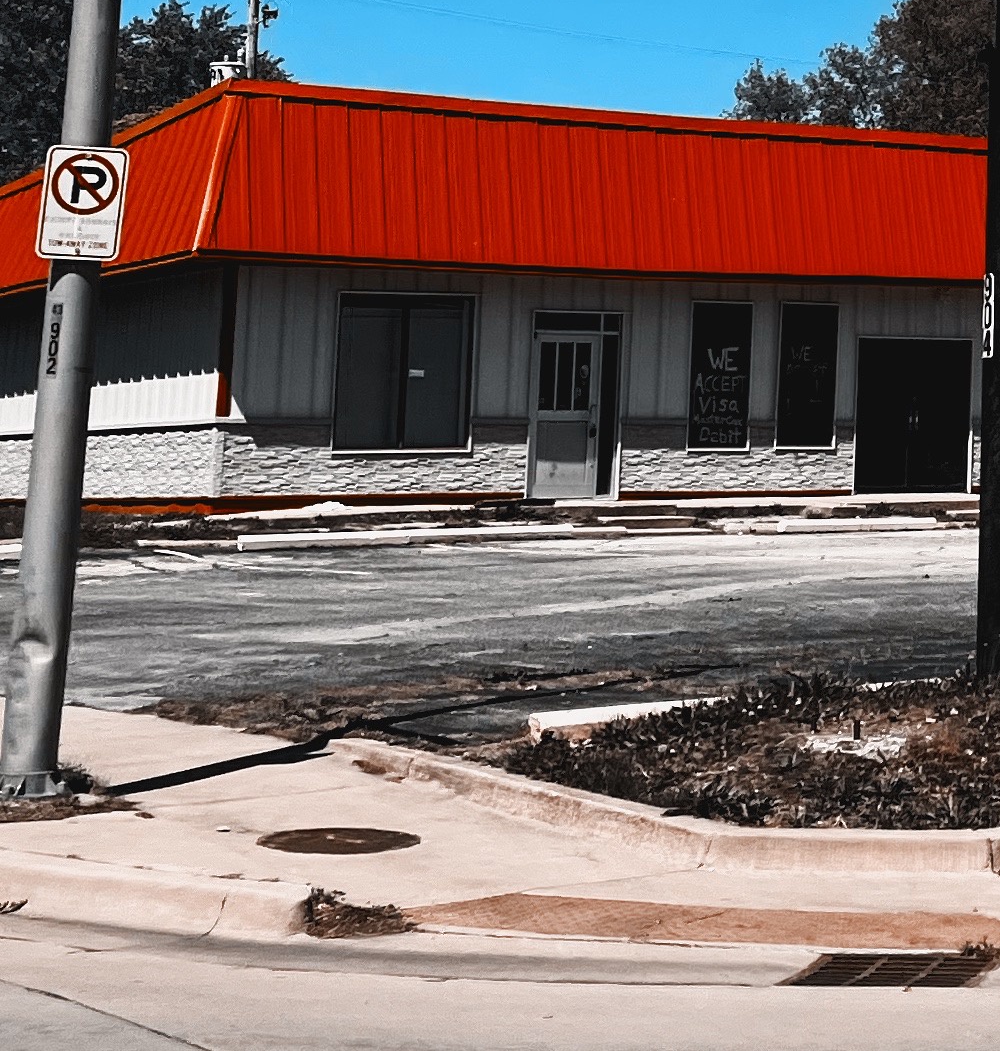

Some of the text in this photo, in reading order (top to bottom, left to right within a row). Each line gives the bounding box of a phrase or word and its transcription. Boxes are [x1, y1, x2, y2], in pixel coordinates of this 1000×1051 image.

[46, 322, 60, 375] 902
[707, 346, 740, 372] WE
[694, 373, 747, 395] ACCEPT
